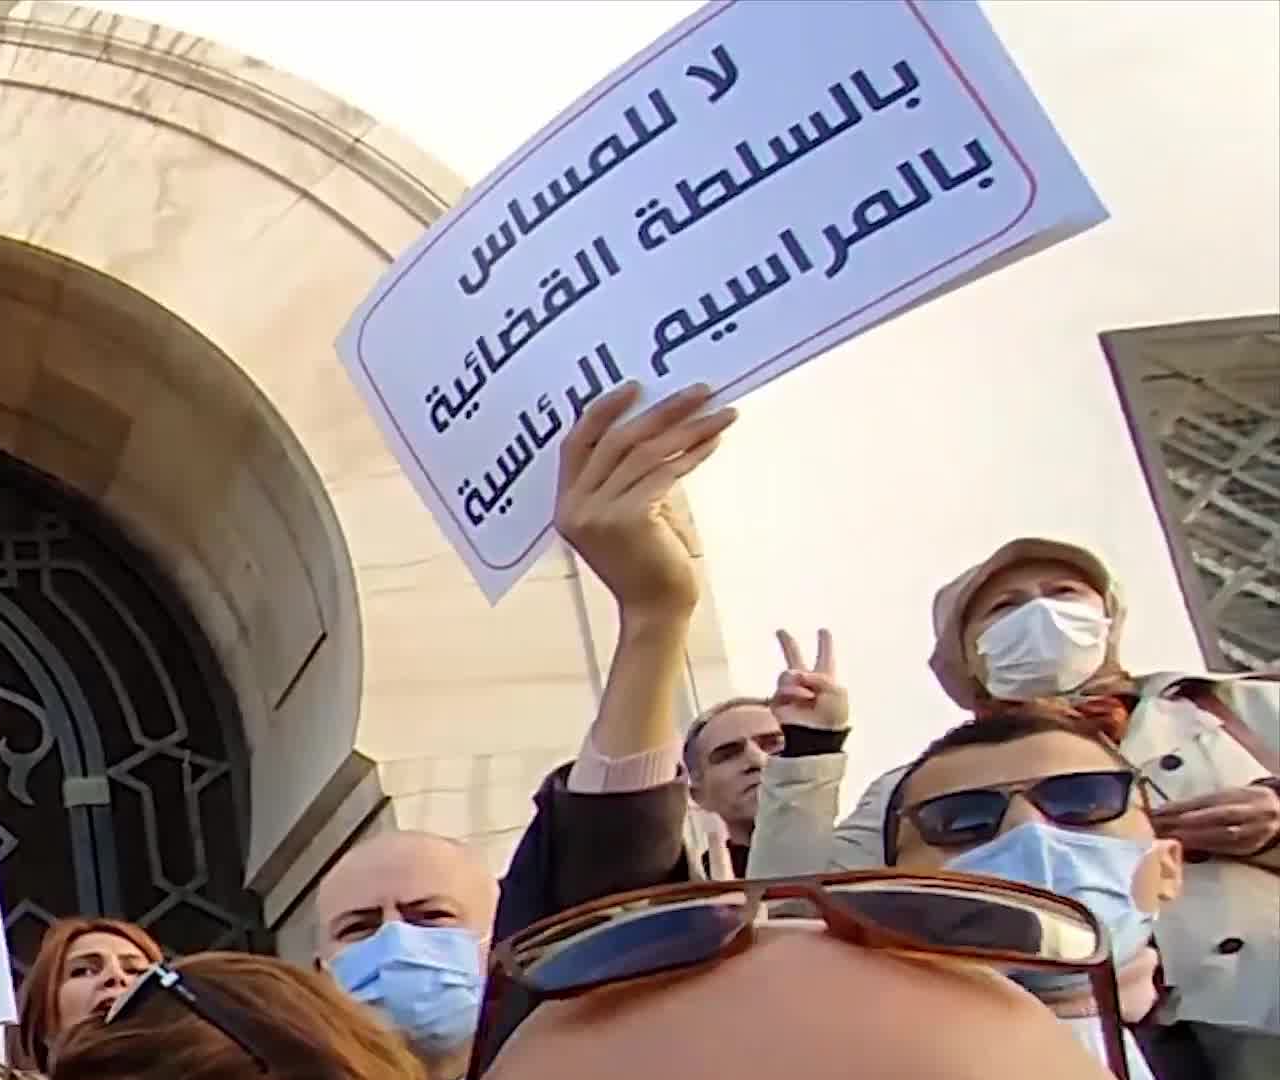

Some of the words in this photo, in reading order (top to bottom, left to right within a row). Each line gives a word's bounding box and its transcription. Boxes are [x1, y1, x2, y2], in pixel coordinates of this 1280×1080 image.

[637, 59, 920, 252] بالسلطة
[686, 44, 738, 102] لا
[458, 88, 678, 294] للمساس
[650, 138, 994, 376] بالمراسيم
[425, 236, 621, 433] القضائية
[462, 342, 624, 526] الرئاسية
